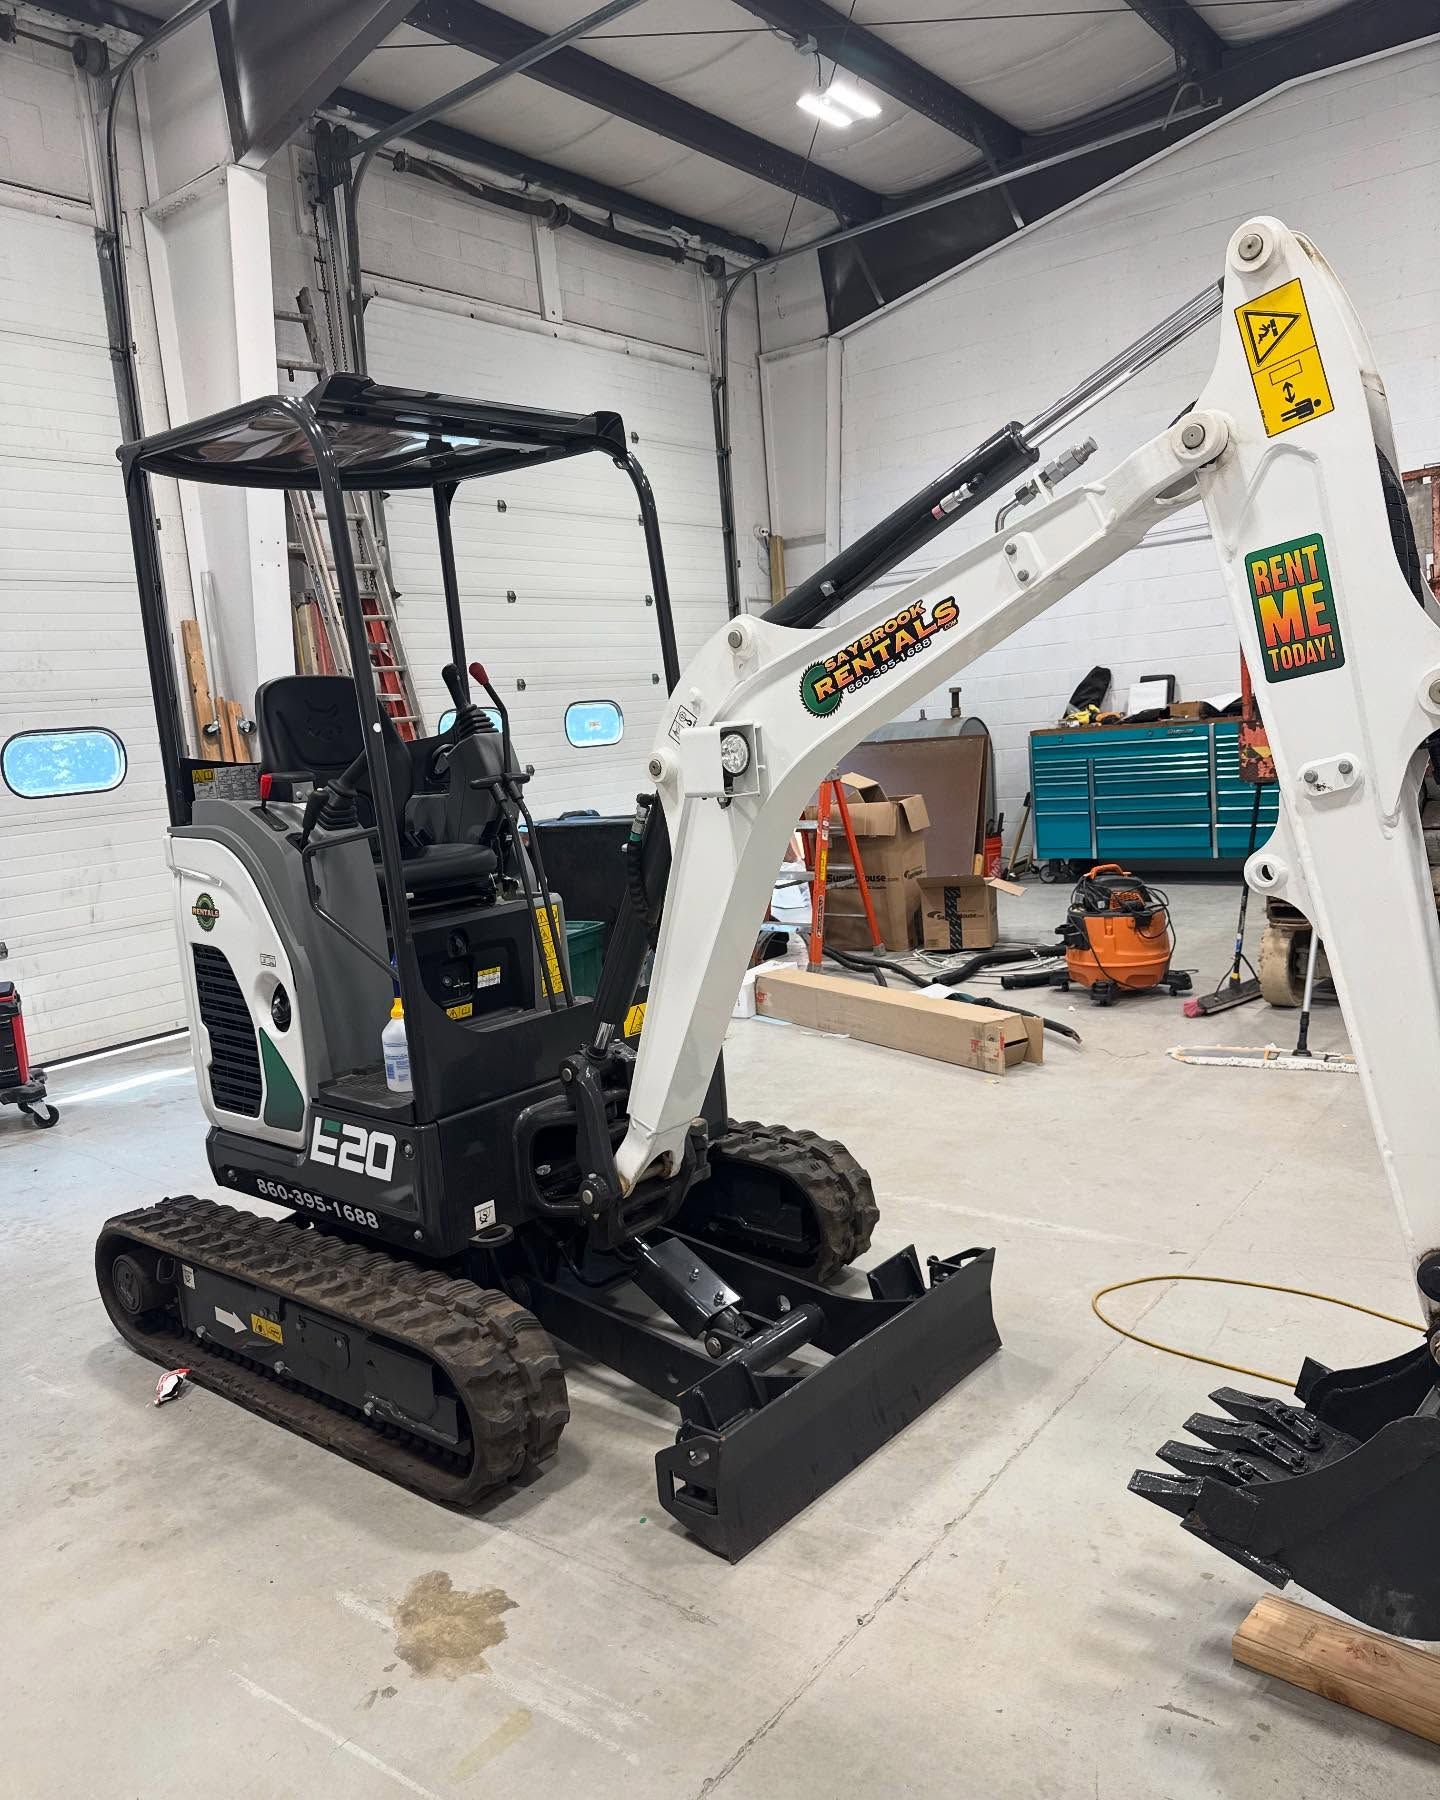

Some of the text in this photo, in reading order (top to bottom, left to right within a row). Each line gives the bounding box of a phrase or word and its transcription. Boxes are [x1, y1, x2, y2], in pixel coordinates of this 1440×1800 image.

[1251, 543, 1319, 595] RENT
[823, 600, 927, 672] SAYBROOK
[1257, 581, 1332, 648] ME
[812, 598, 959, 702] RENTALS
[848, 638, 931, 693] 860-395-1688
[1267, 634, 1336, 672] TODAY!
[192, 907, 219, 917] RENTALS
[309, 1116, 397, 1182] E20
[256, 1178, 380, 1230] 860-395-1688
